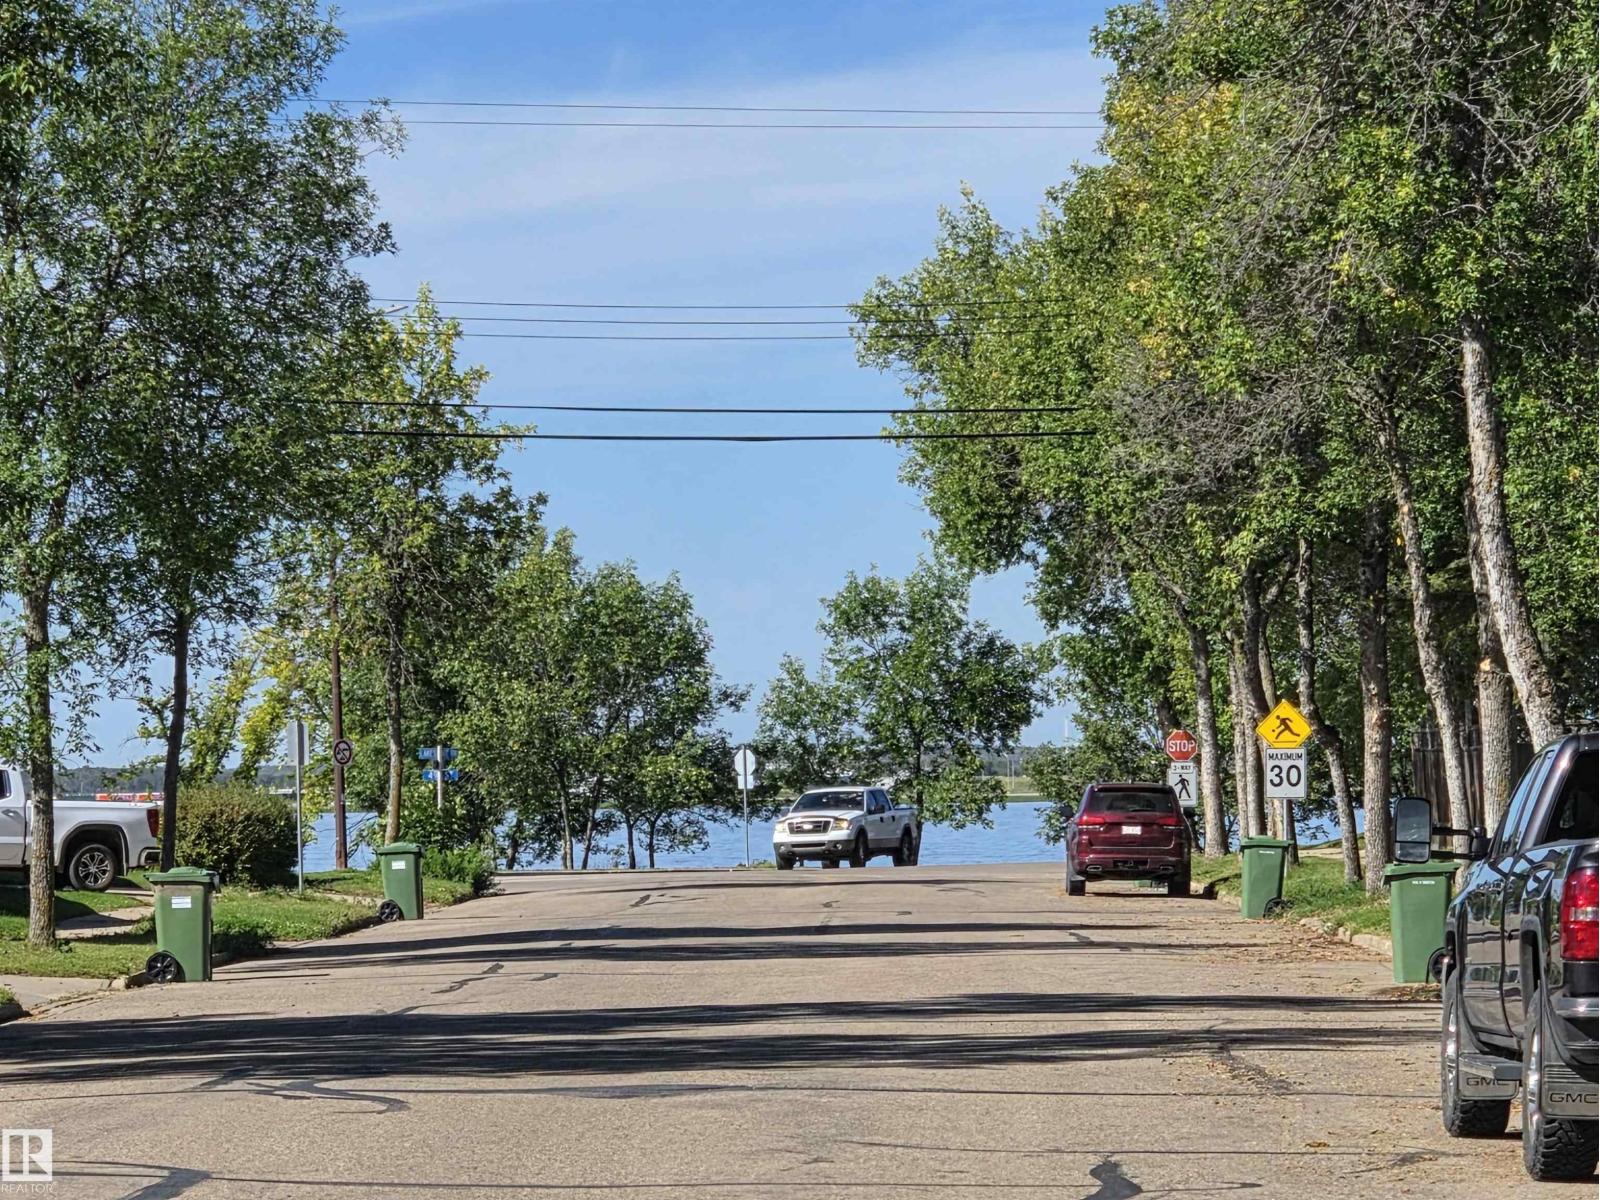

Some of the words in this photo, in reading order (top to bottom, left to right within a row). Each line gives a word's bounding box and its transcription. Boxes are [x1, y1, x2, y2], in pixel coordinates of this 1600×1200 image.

[1169, 740, 1195, 752] STOP
[1268, 752, 1303, 761] MAXIMUM
[1270, 764, 1302, 787] 30
[1550, 1092, 1598, 1104] GMC
